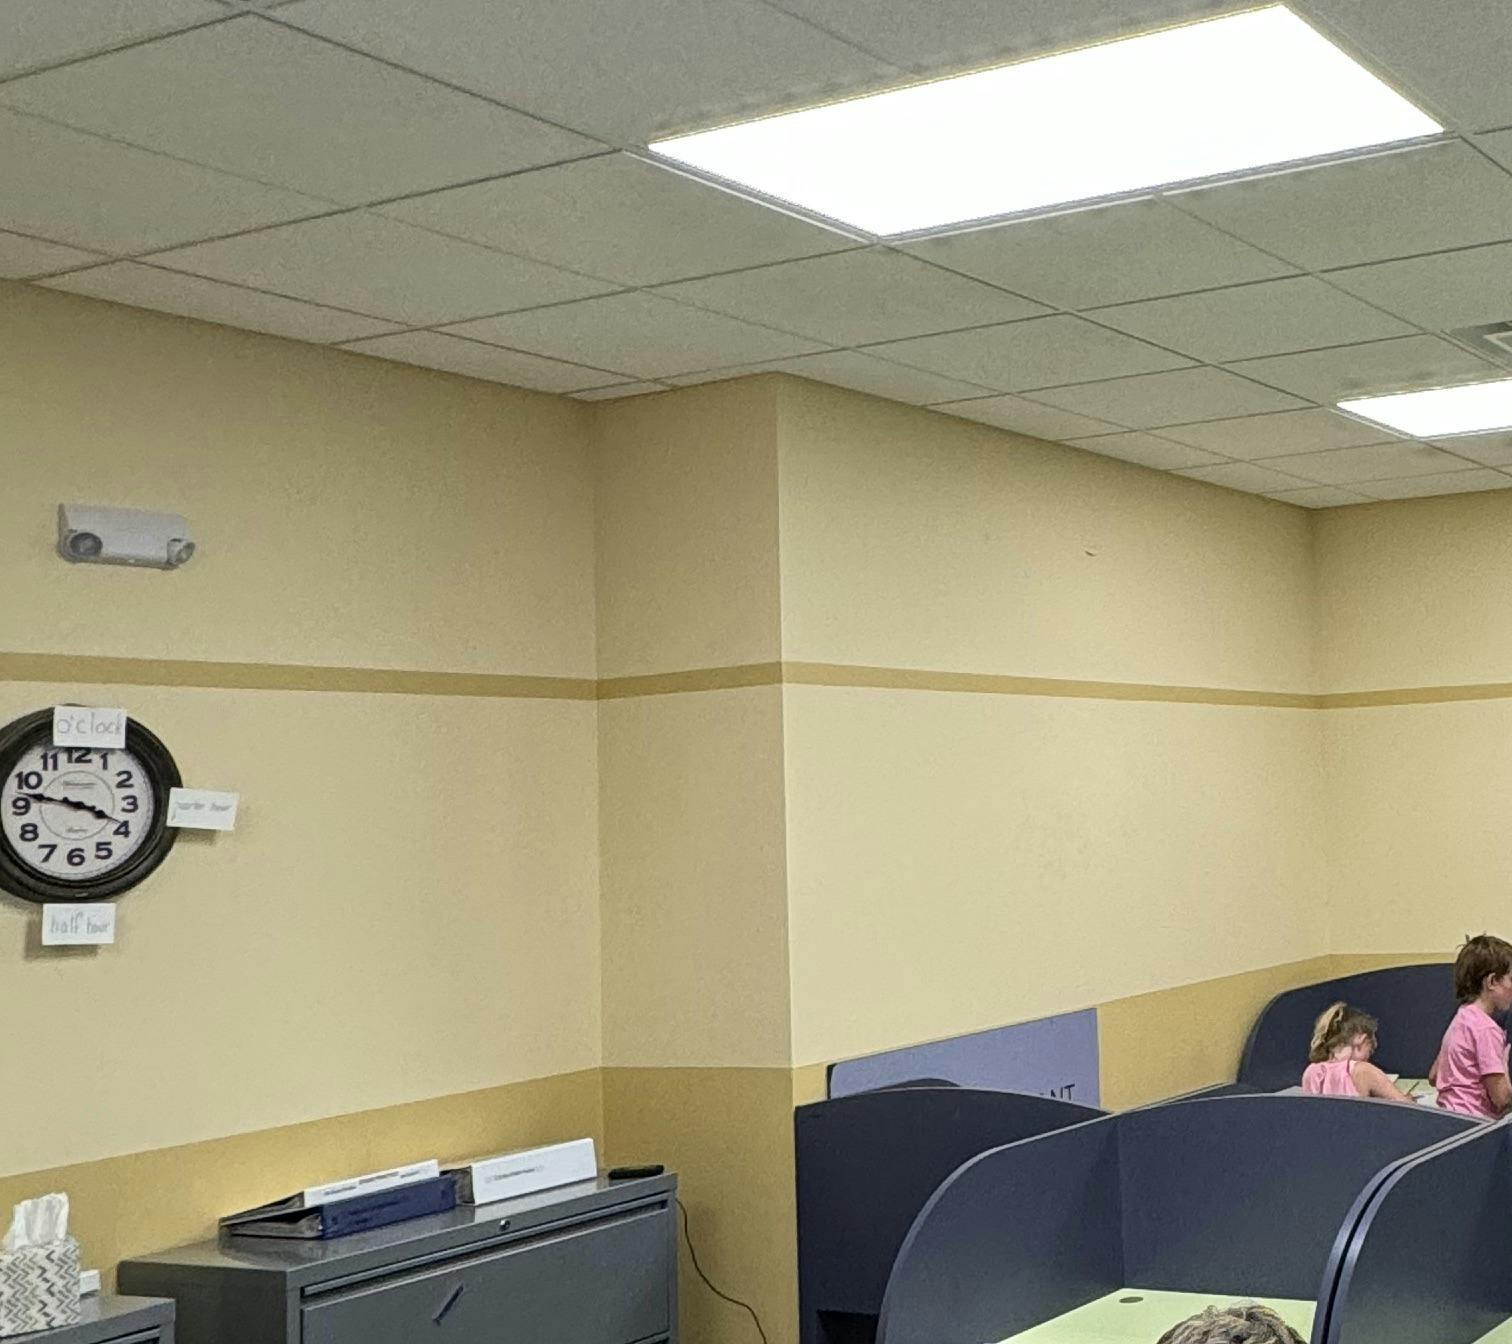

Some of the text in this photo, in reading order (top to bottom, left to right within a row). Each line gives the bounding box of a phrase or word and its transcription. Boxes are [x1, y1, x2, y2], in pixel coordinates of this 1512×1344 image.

[56, 715, 123, 735] o'clock
[41, 753, 59, 771] 11
[66, 746, 92, 764] 12
[99, 752, 109, 771] 1
[15, 771, 43, 790] 10
[115, 770, 134, 789] 2
[12, 797, 31, 816] 9
[121, 795, 139, 813] 3
[19, 823, 39, 842] 8
[112, 820, 131, 838] 4
[38, 844, 58, 863] 7
[66, 848, 86, 866] 6
[95, 841, 113, 860] 5
